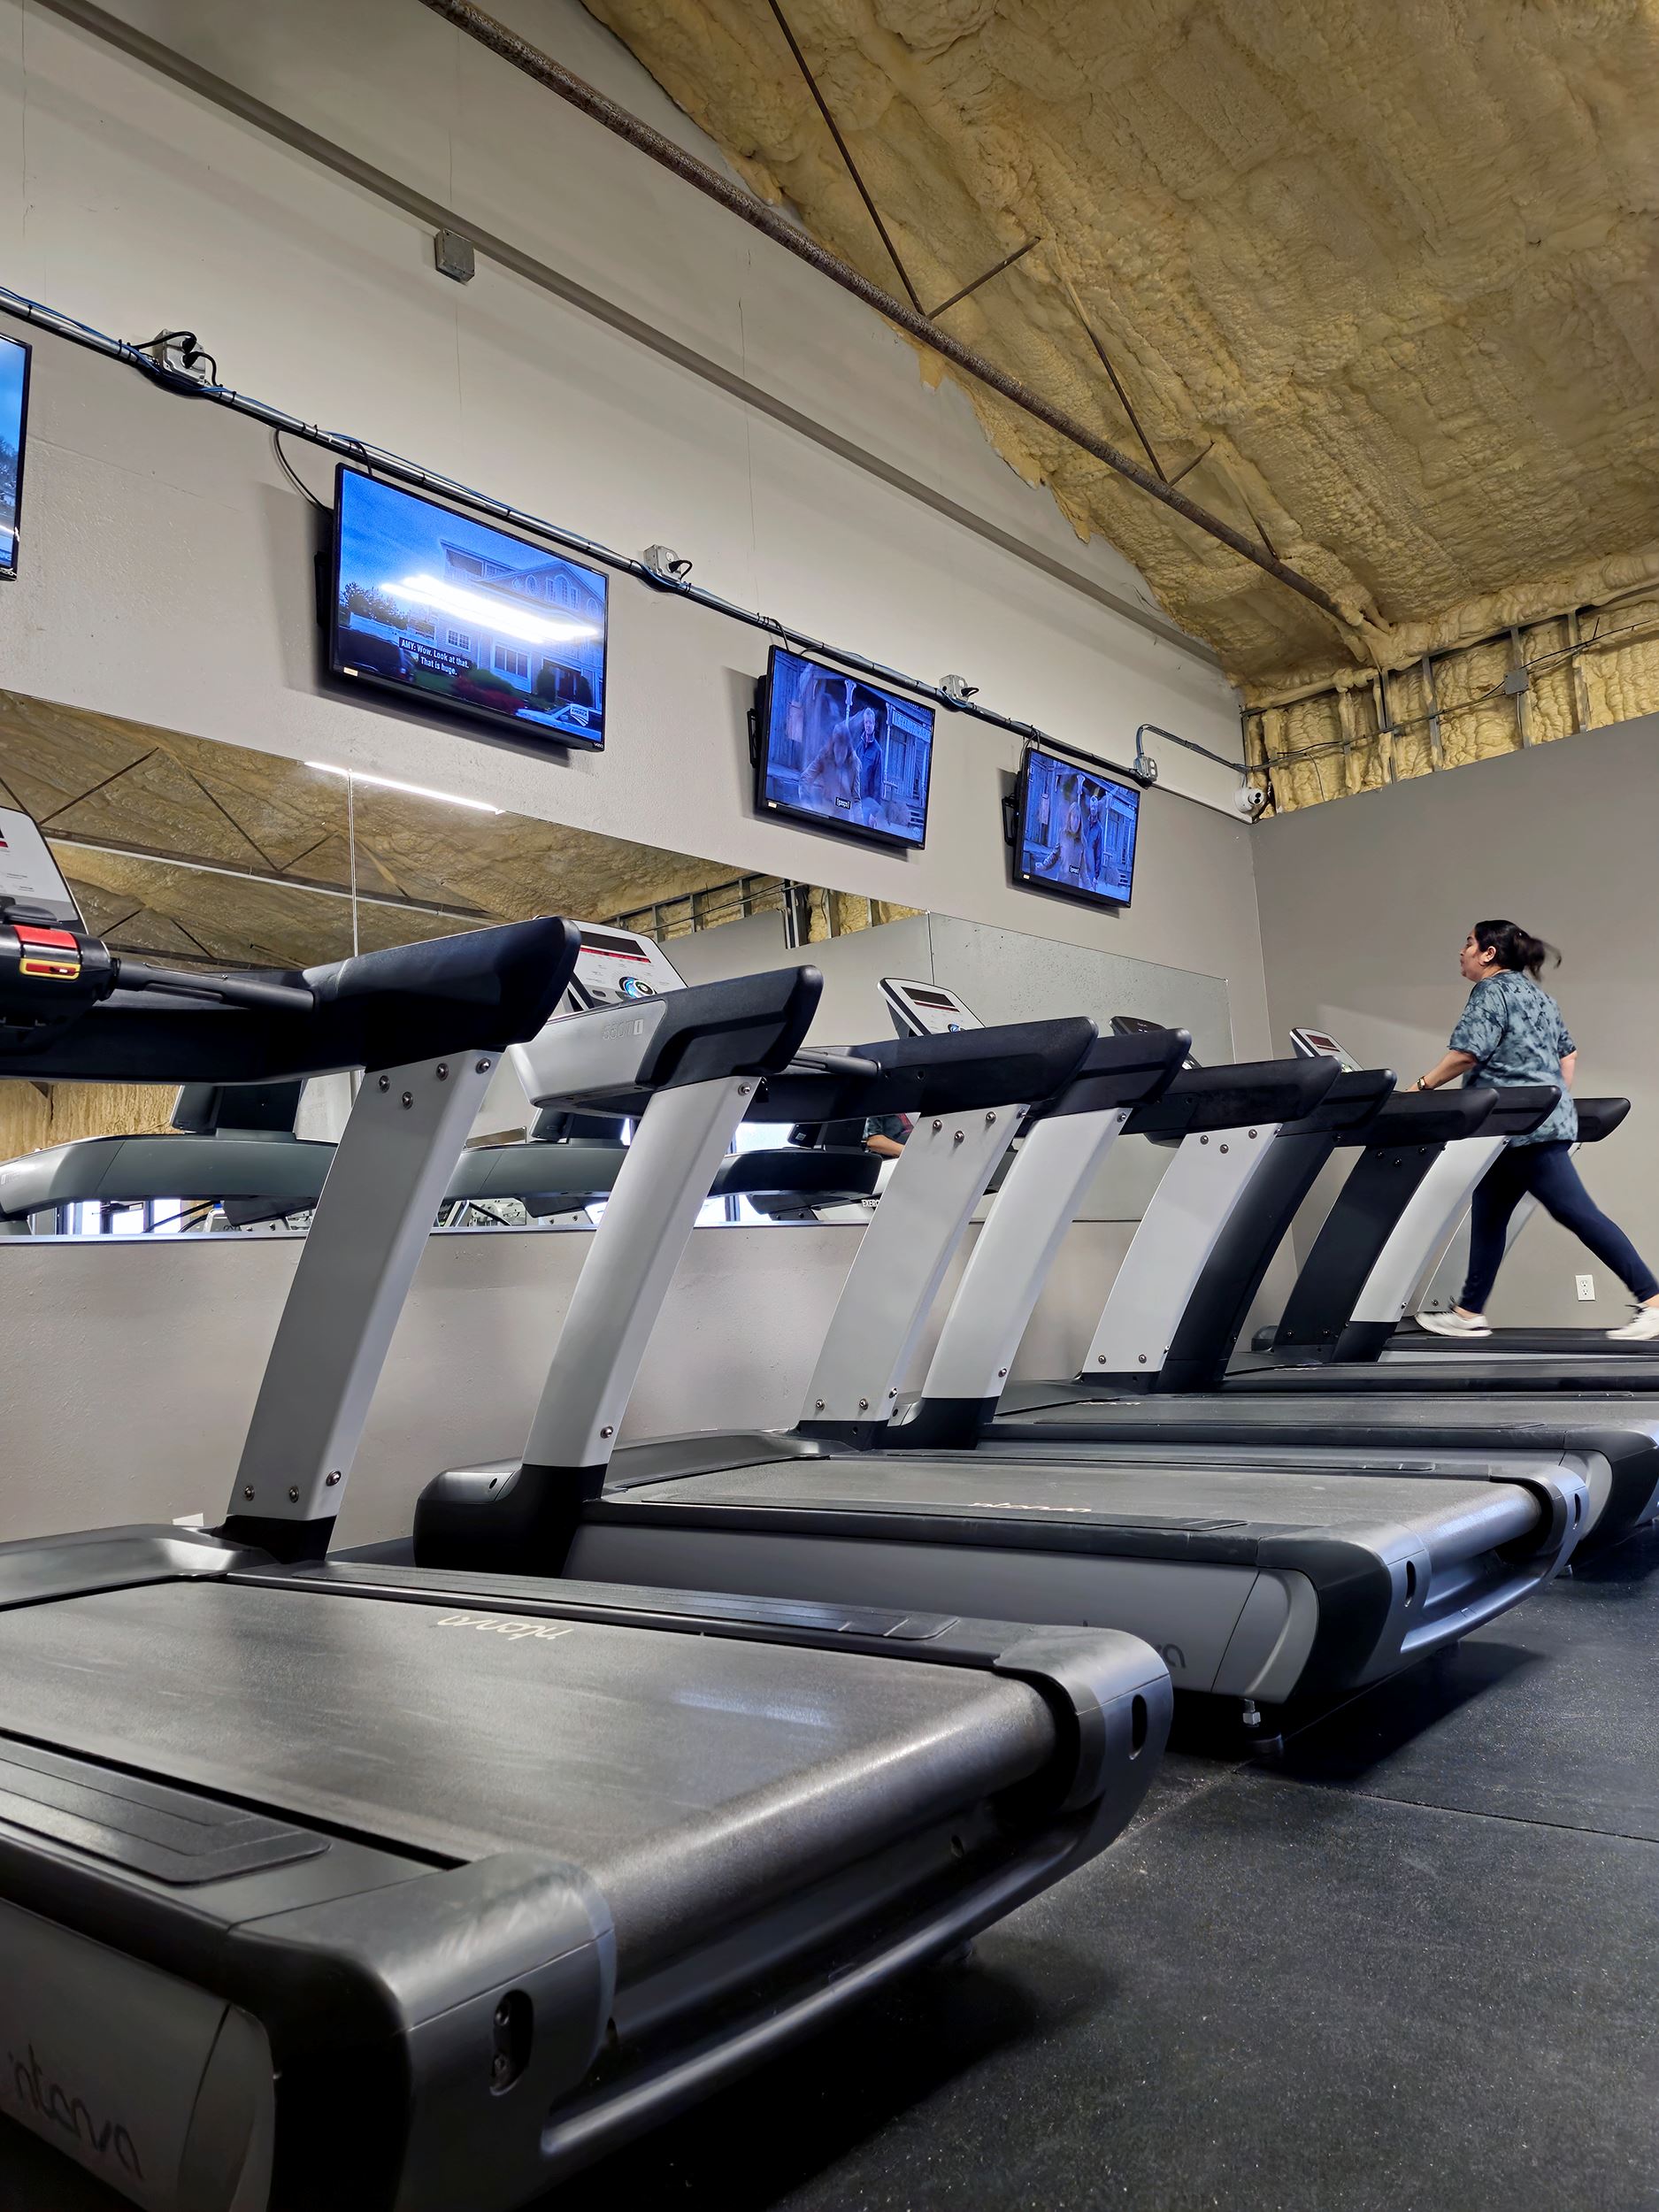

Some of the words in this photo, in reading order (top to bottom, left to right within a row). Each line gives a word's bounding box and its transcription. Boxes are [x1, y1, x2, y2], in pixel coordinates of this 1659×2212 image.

[417, 644, 433, 657] Wow.
[434, 649, 448, 662] Look
[456, 657, 470, 669] that.
[420, 657, 434, 668] That
[434, 660, 441, 670] is
[441, 663, 457, 675] huge.
